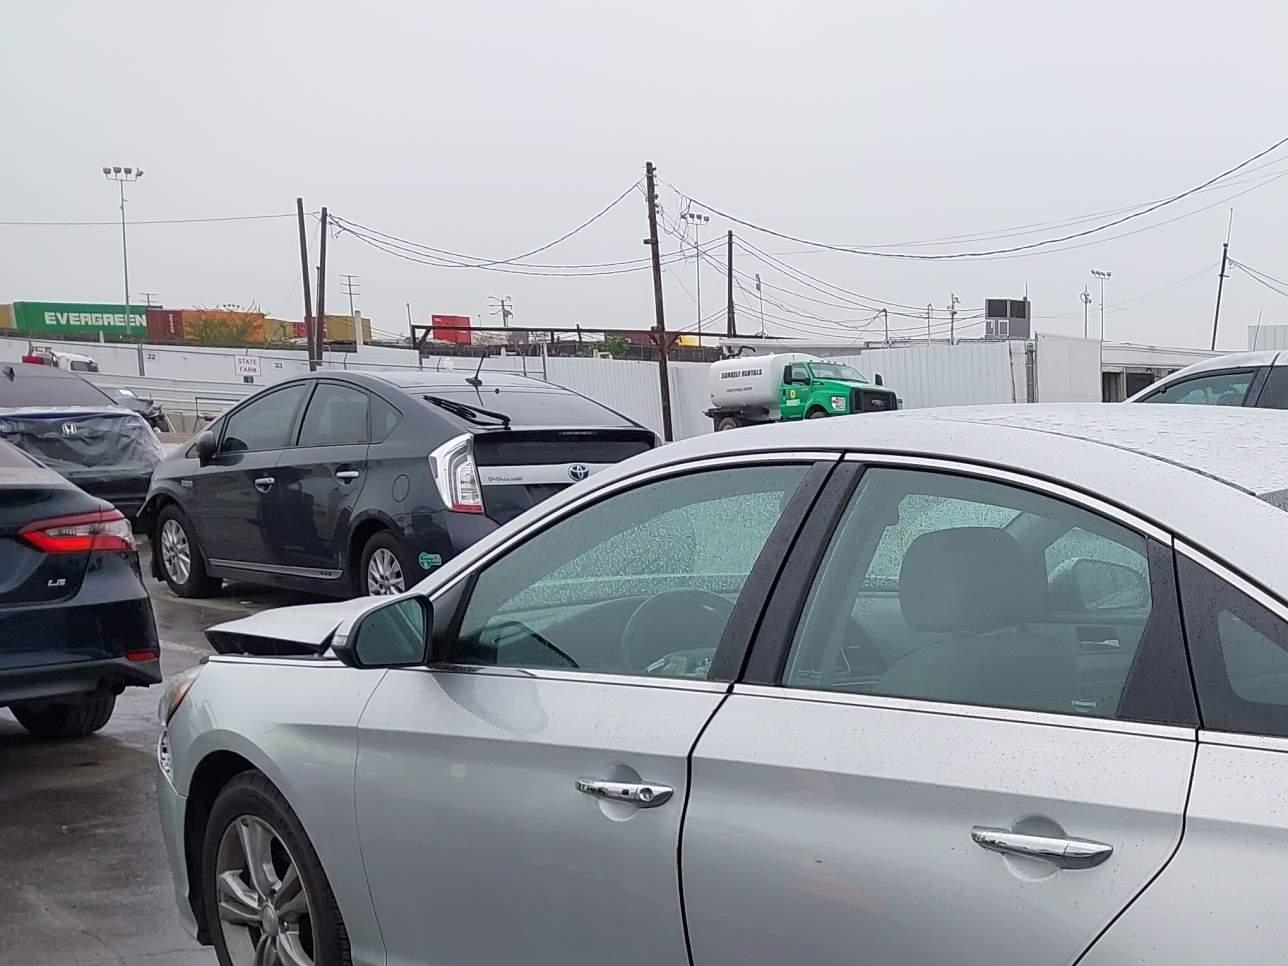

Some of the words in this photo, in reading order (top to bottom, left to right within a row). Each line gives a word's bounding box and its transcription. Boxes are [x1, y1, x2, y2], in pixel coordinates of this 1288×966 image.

[44, 312, 147, 327] EVERGREEN
[238, 358, 257, 366] STATE
[239, 366, 257, 374] FARM
